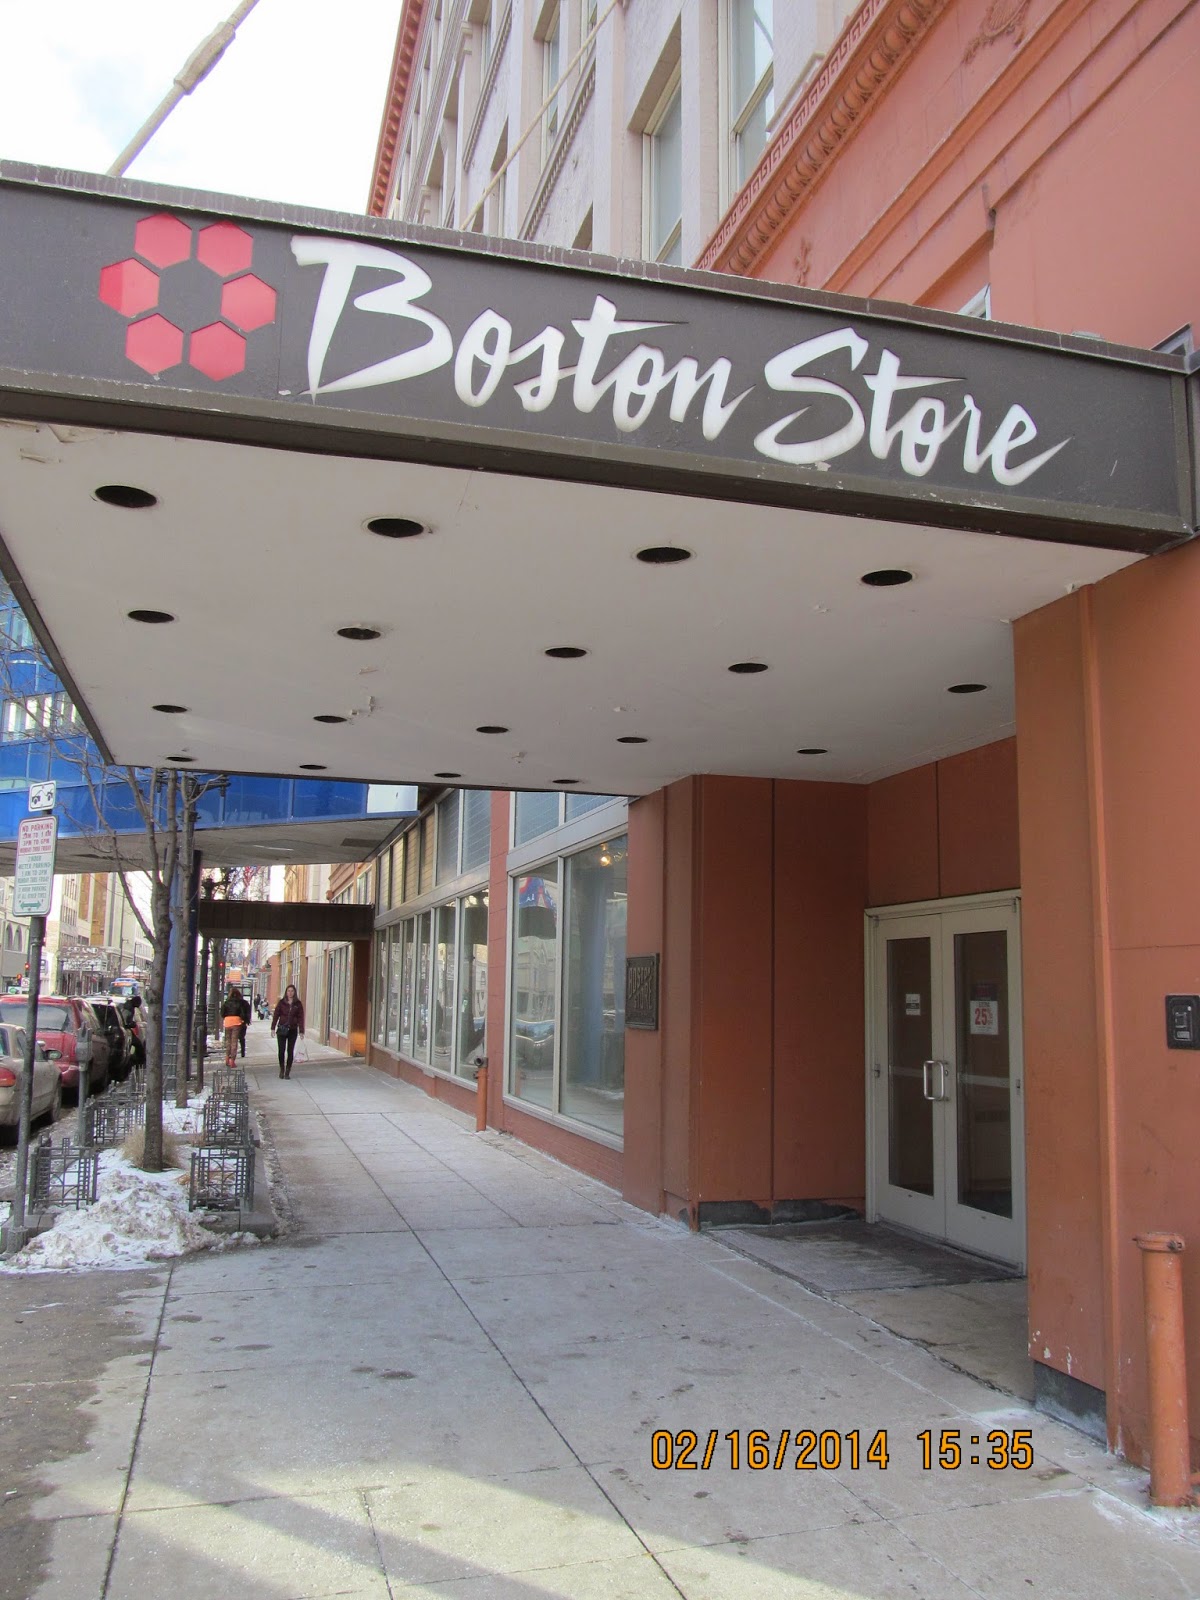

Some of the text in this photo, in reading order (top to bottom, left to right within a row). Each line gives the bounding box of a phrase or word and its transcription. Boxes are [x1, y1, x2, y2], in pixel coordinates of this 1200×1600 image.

[290, 235, 1073, 486] Boston Store
[31, 823, 53, 831] PARKING
